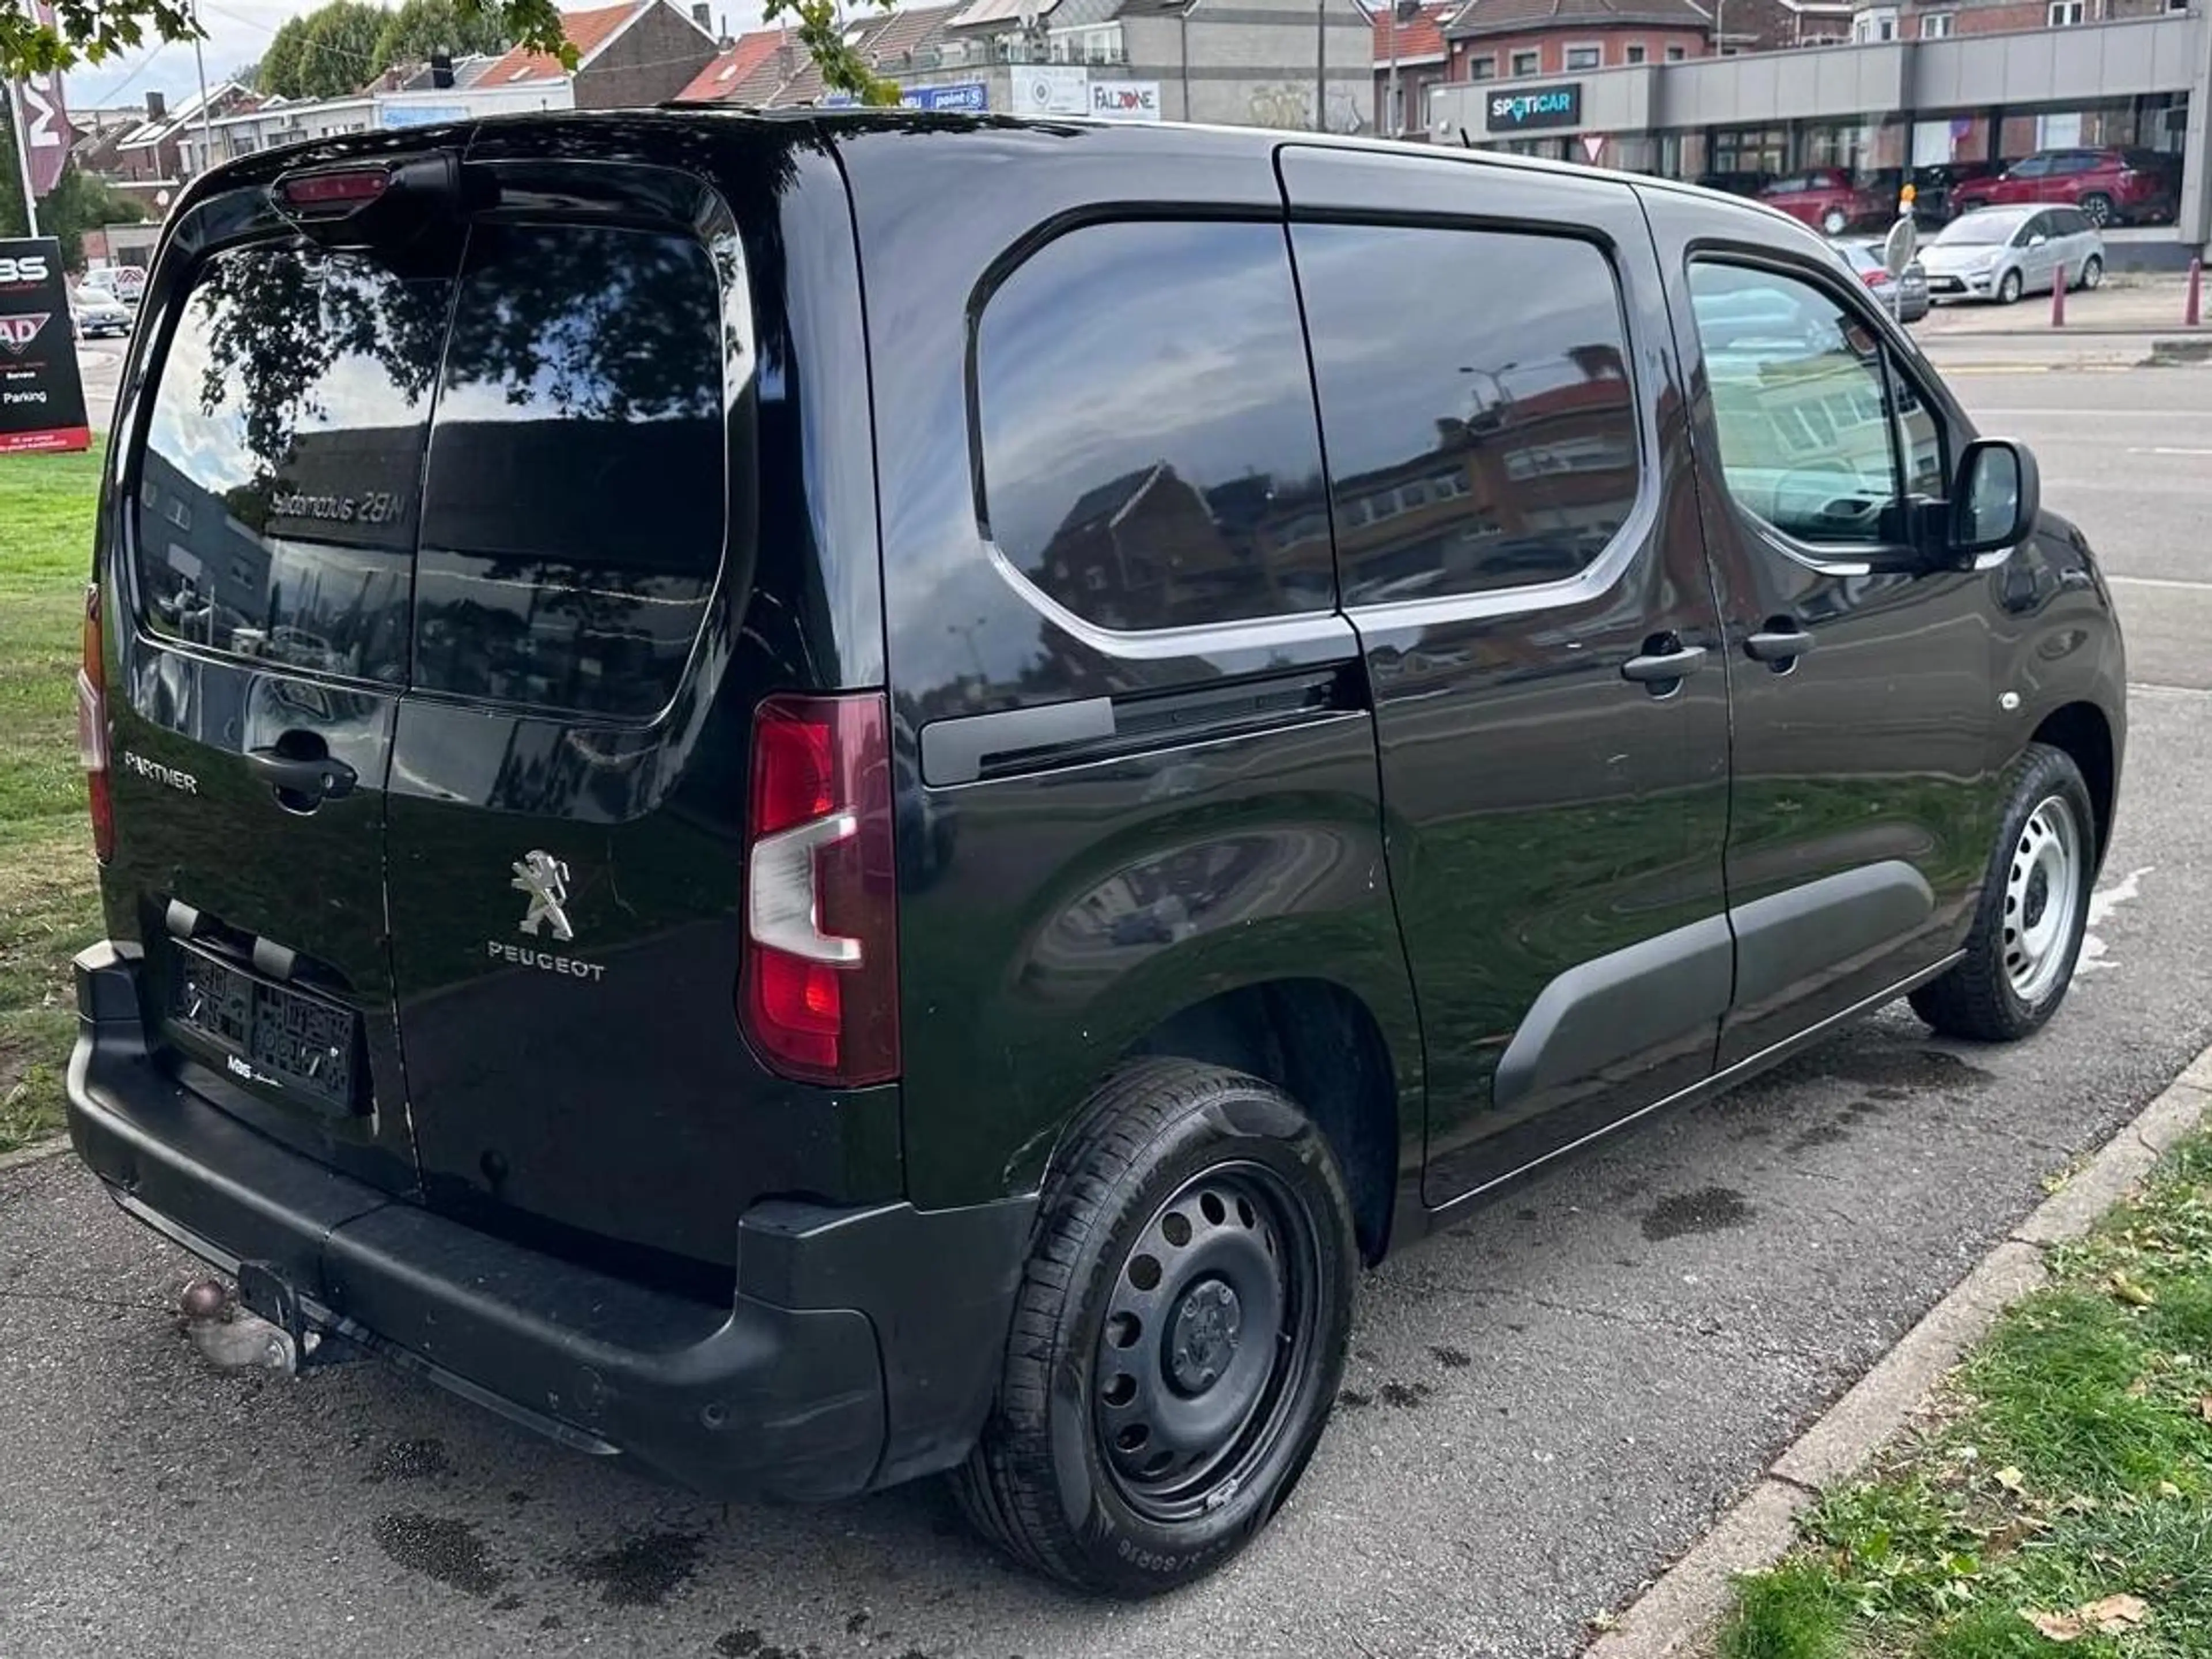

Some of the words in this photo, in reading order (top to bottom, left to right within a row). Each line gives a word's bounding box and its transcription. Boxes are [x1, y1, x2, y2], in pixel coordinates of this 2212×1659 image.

[1094, 86, 1155, 110] FALZONE
[3, 391, 47, 403] Parking
[125, 751, 197, 794] PARTNER
[488, 940, 606, 983] PEUGEOT
